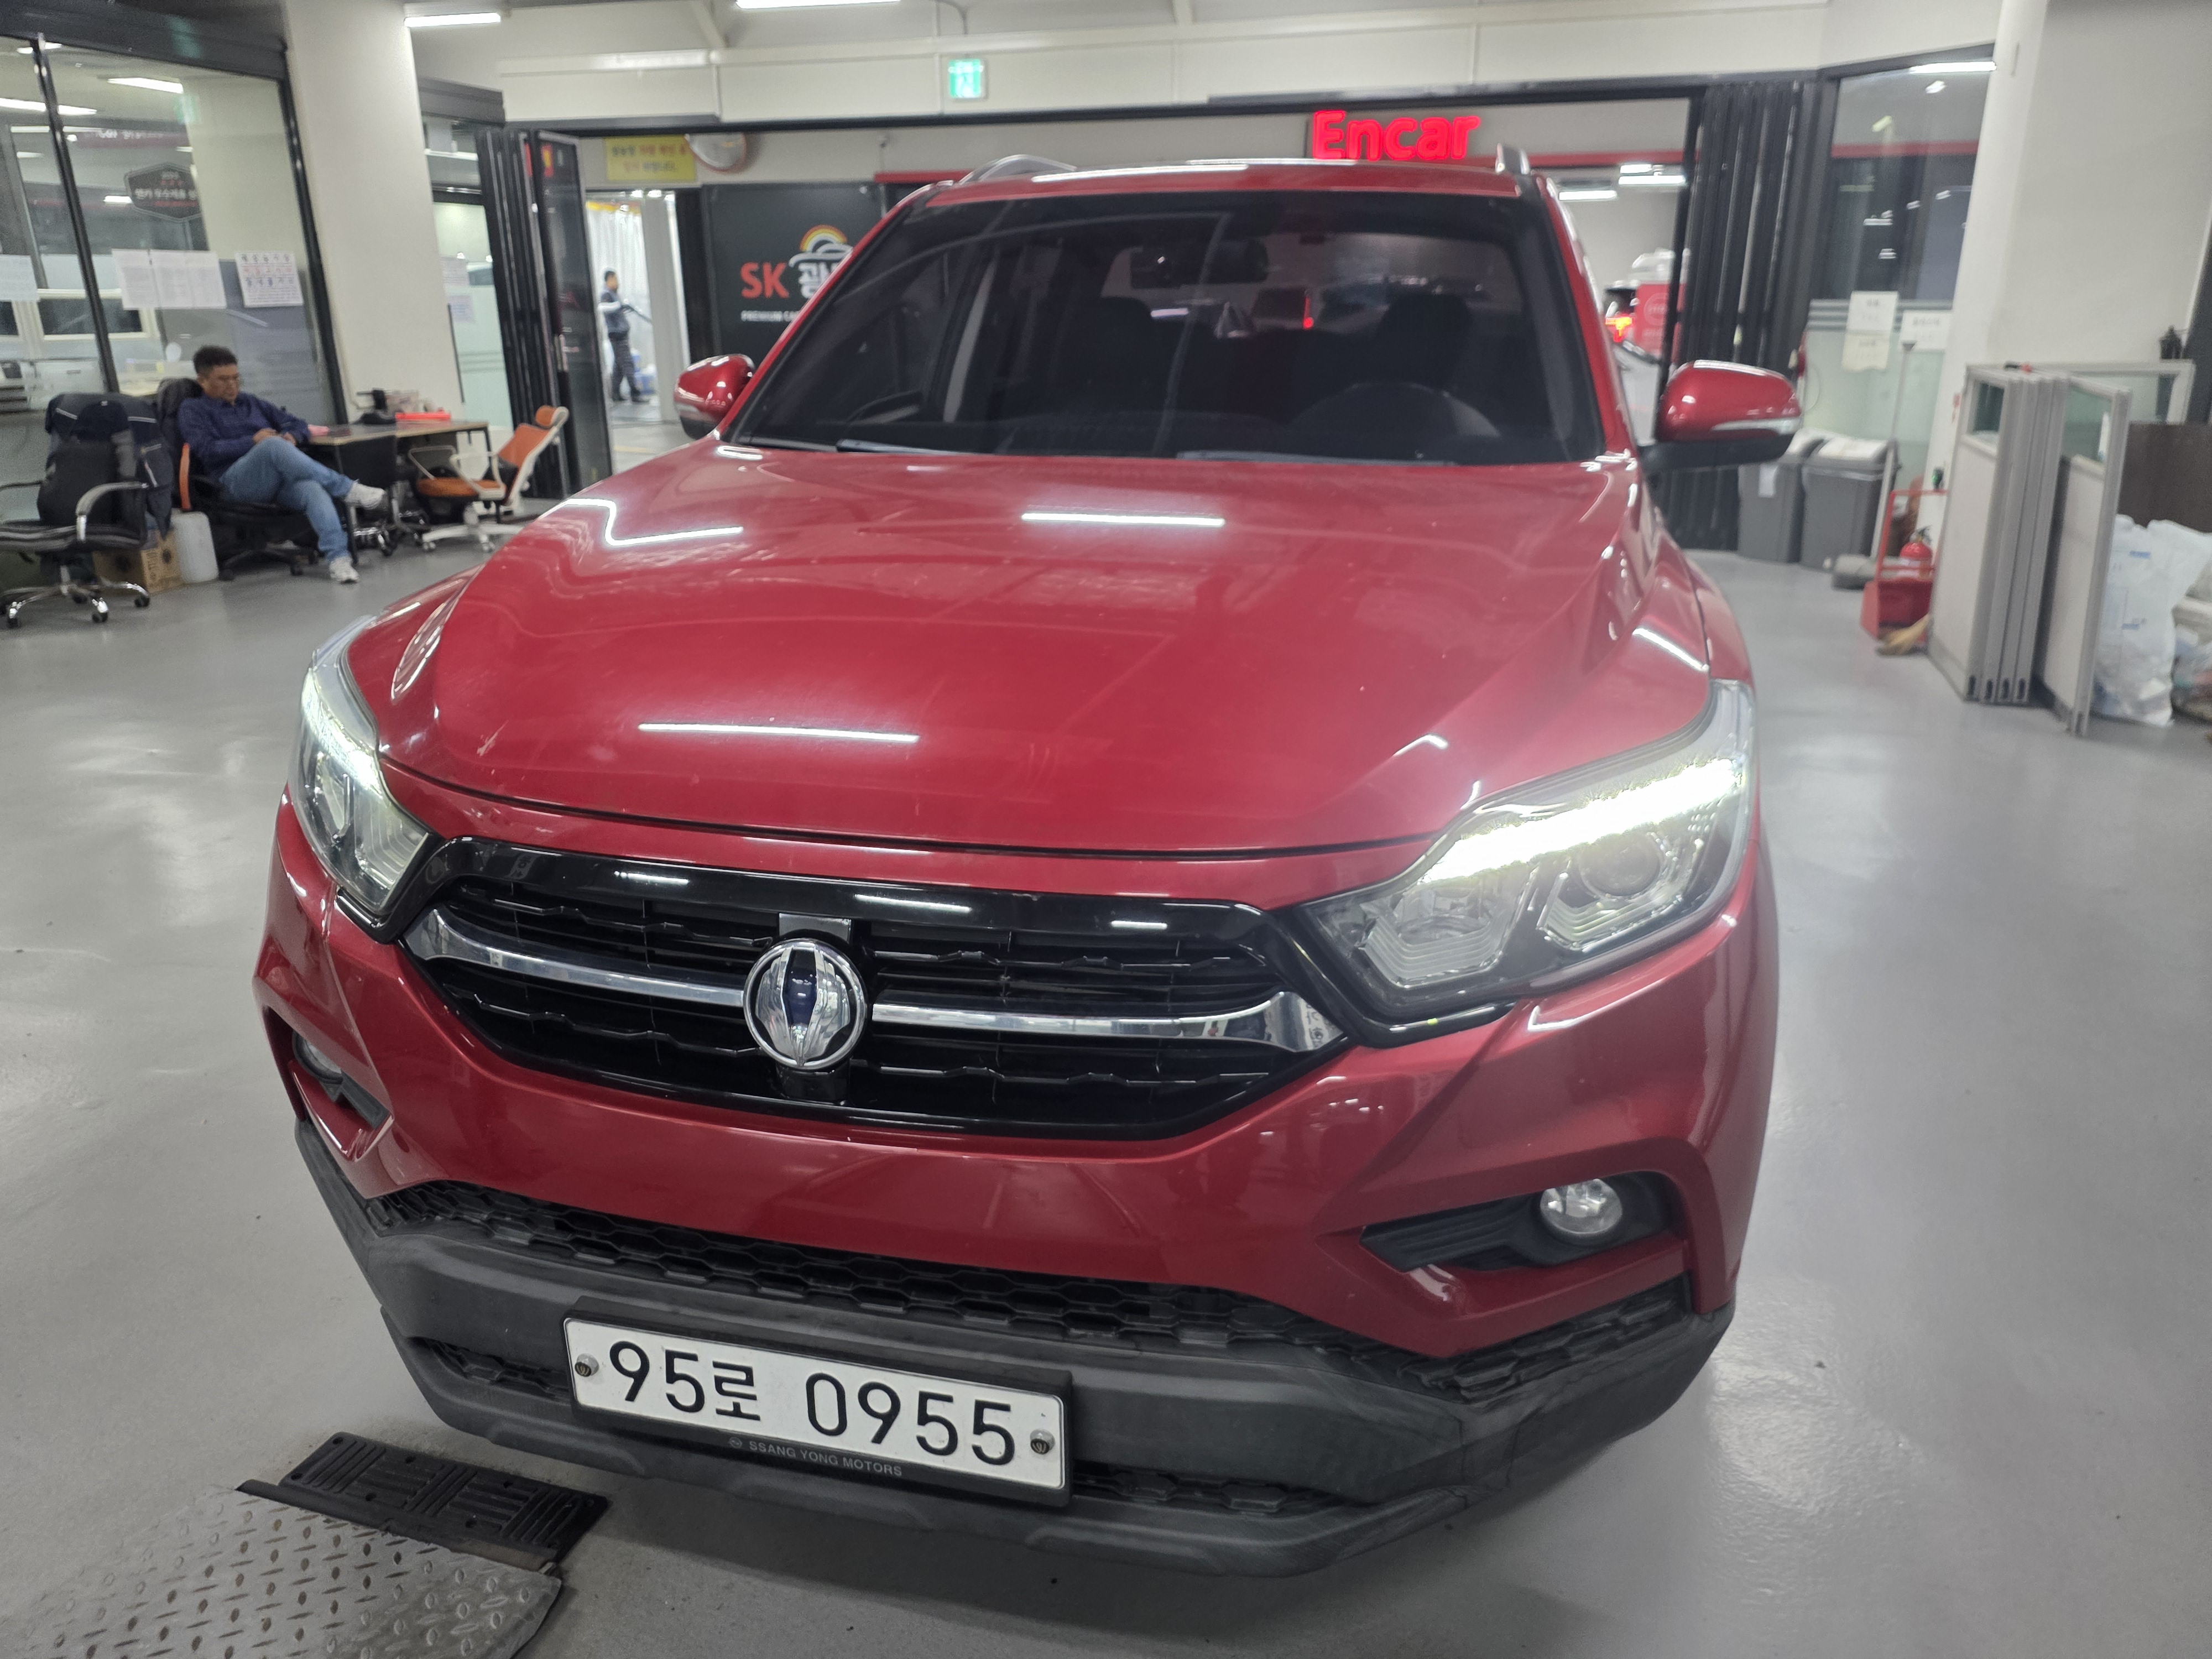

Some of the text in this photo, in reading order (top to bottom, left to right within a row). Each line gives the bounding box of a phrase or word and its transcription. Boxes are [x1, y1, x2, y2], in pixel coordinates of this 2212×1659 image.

[1312, 110, 1481, 161] Encar
[740, 262, 839, 299] SK 광
[609, 1340, 1015, 1465] 95로 0955
[749, 1441, 902, 1476] SSANG YONG MOTORS
